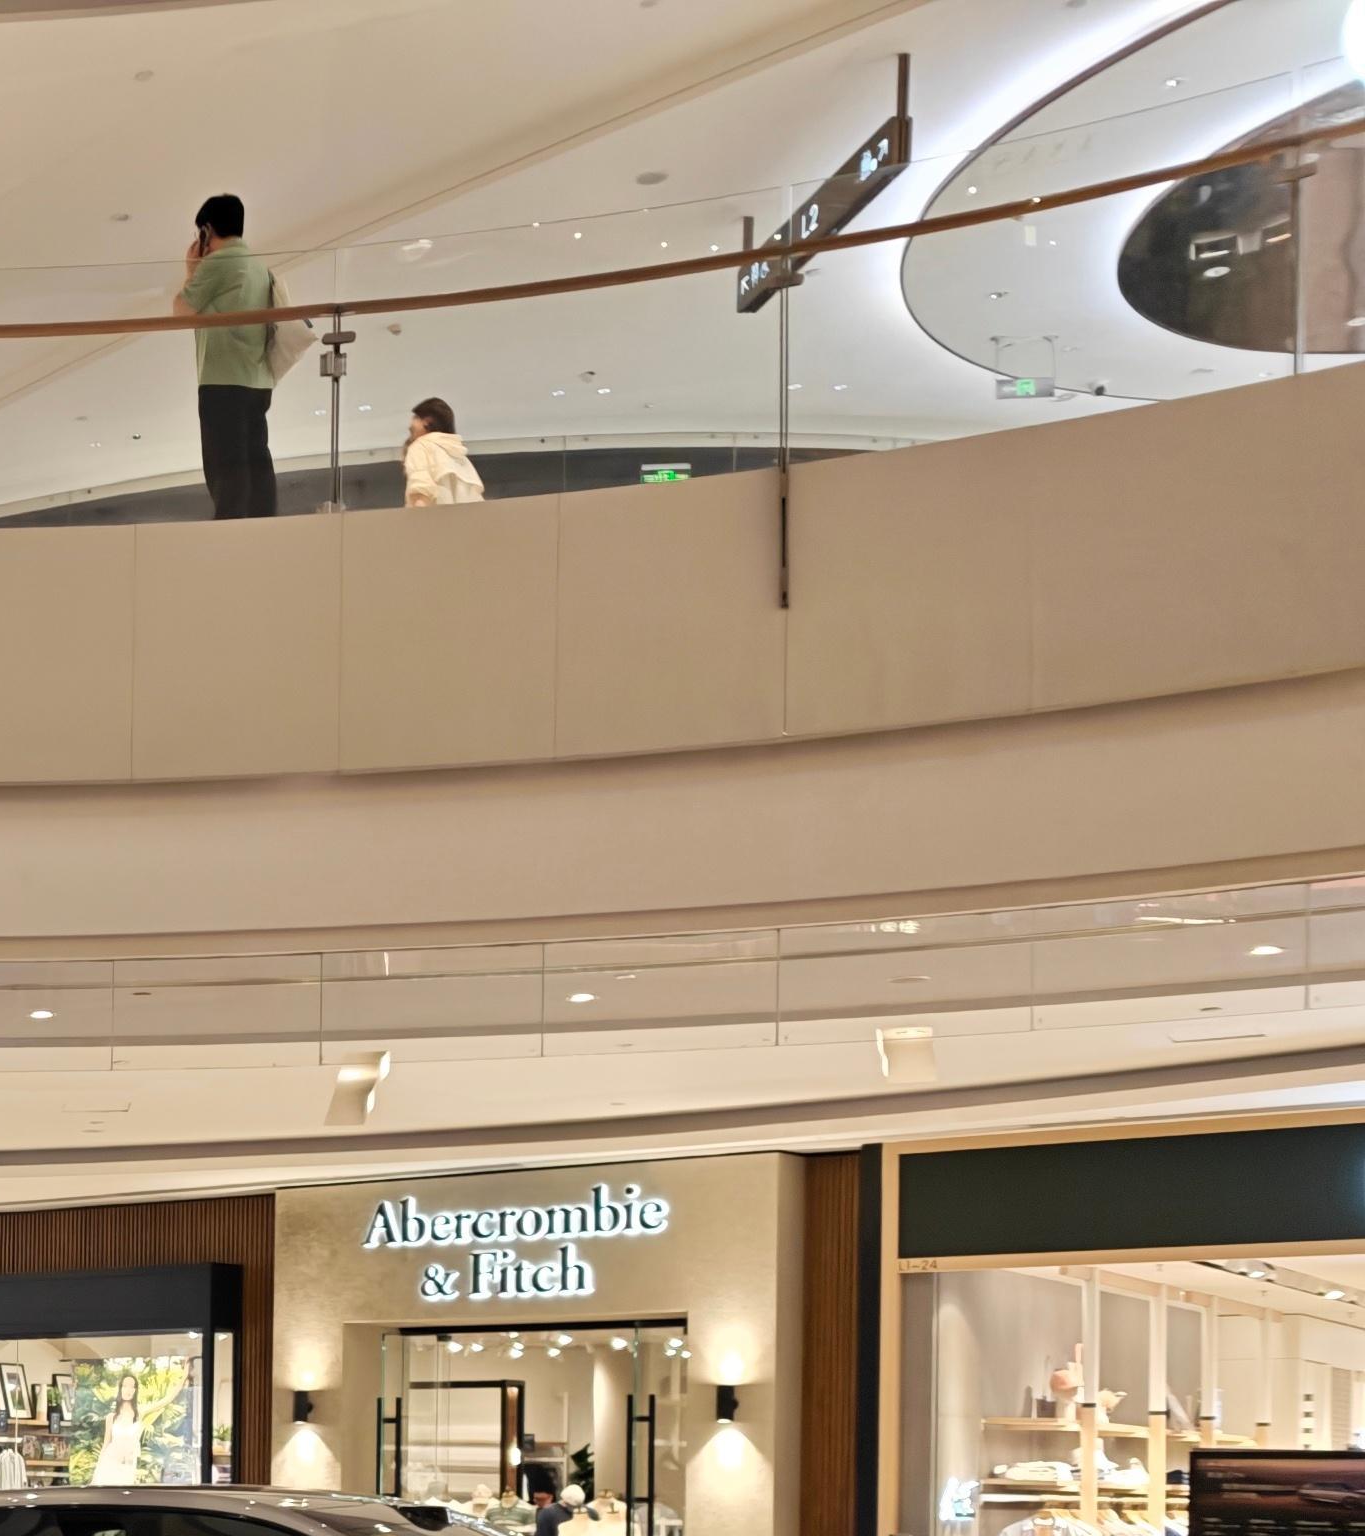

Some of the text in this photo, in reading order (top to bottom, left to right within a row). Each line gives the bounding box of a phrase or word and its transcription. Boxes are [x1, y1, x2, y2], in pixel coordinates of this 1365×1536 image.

[801, 203, 820, 240] L2
[361, 1183, 669, 1248] Abercrombie
[420, 1242, 595, 1301] & Fitch
